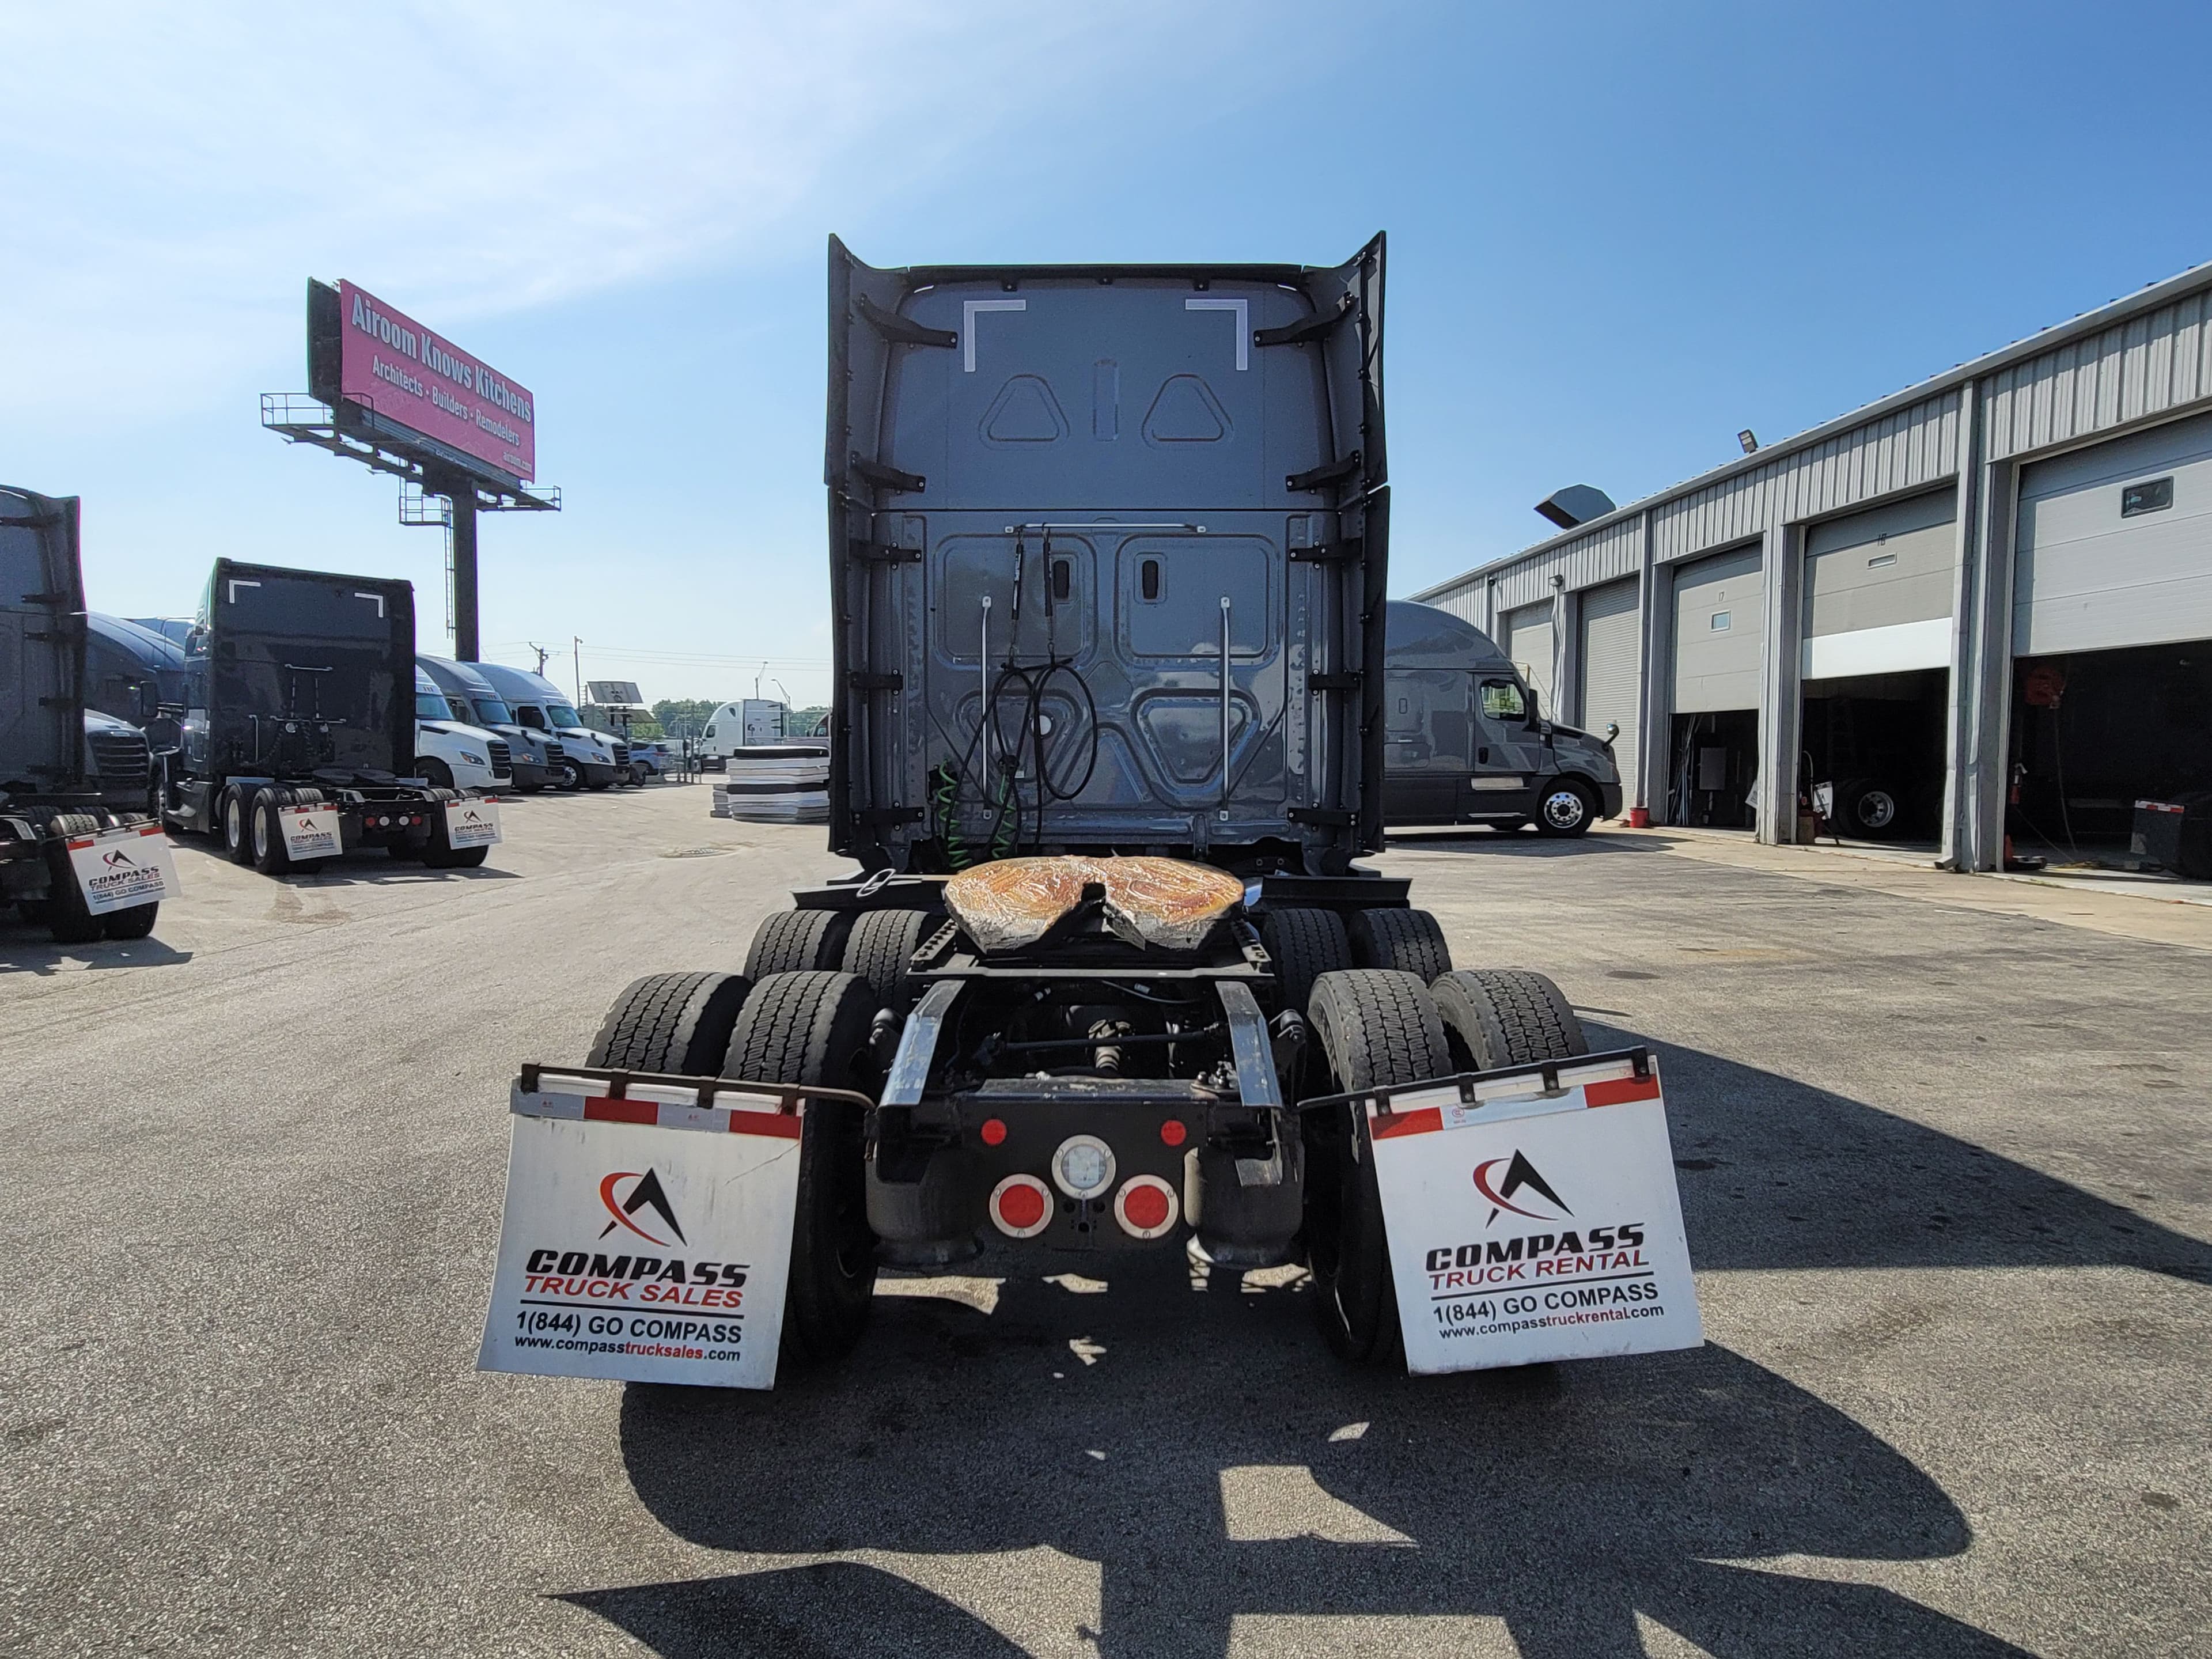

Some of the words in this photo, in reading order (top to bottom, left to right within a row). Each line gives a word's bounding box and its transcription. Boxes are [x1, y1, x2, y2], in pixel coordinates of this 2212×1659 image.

[351, 293, 417, 359] Airoom
[421, 332, 472, 389] Knows
[475, 365, 531, 422] Kitchens
[373, 355, 423, 397] Architects
[433, 386, 468, 420] Builders
[476, 410, 520, 446] Remodelers
[89, 866, 159, 886] COMPASS
[90, 880, 124, 891] TRUCK
[127, 873, 160, 883] SALES
[128, 881, 164, 892] COMPASS
[1425, 1222, 1645, 1271] COMPASS
[526, 1249, 750, 1287] COMPASS
[1429, 1266, 1527, 1290] TRUCK
[1535, 1249, 1650, 1278] RENTAL
[524, 1275, 633, 1300] TRUCK
[639, 1284, 744, 1308] SALES
[1433, 1298, 1497, 1326] 1(844)
[1503, 1294, 1538, 1315] GO
[1544, 1282, 1659, 1310] COMPASS
[516, 1310, 581, 1337] 1(844)
[588, 1315, 624, 1337] GO
[630, 1319, 741, 1343] COMPASS
[1438, 1305, 1664, 1339] www.compasstruckrental.com
[514, 1336, 741, 1361] www.compasstrucksales.com
